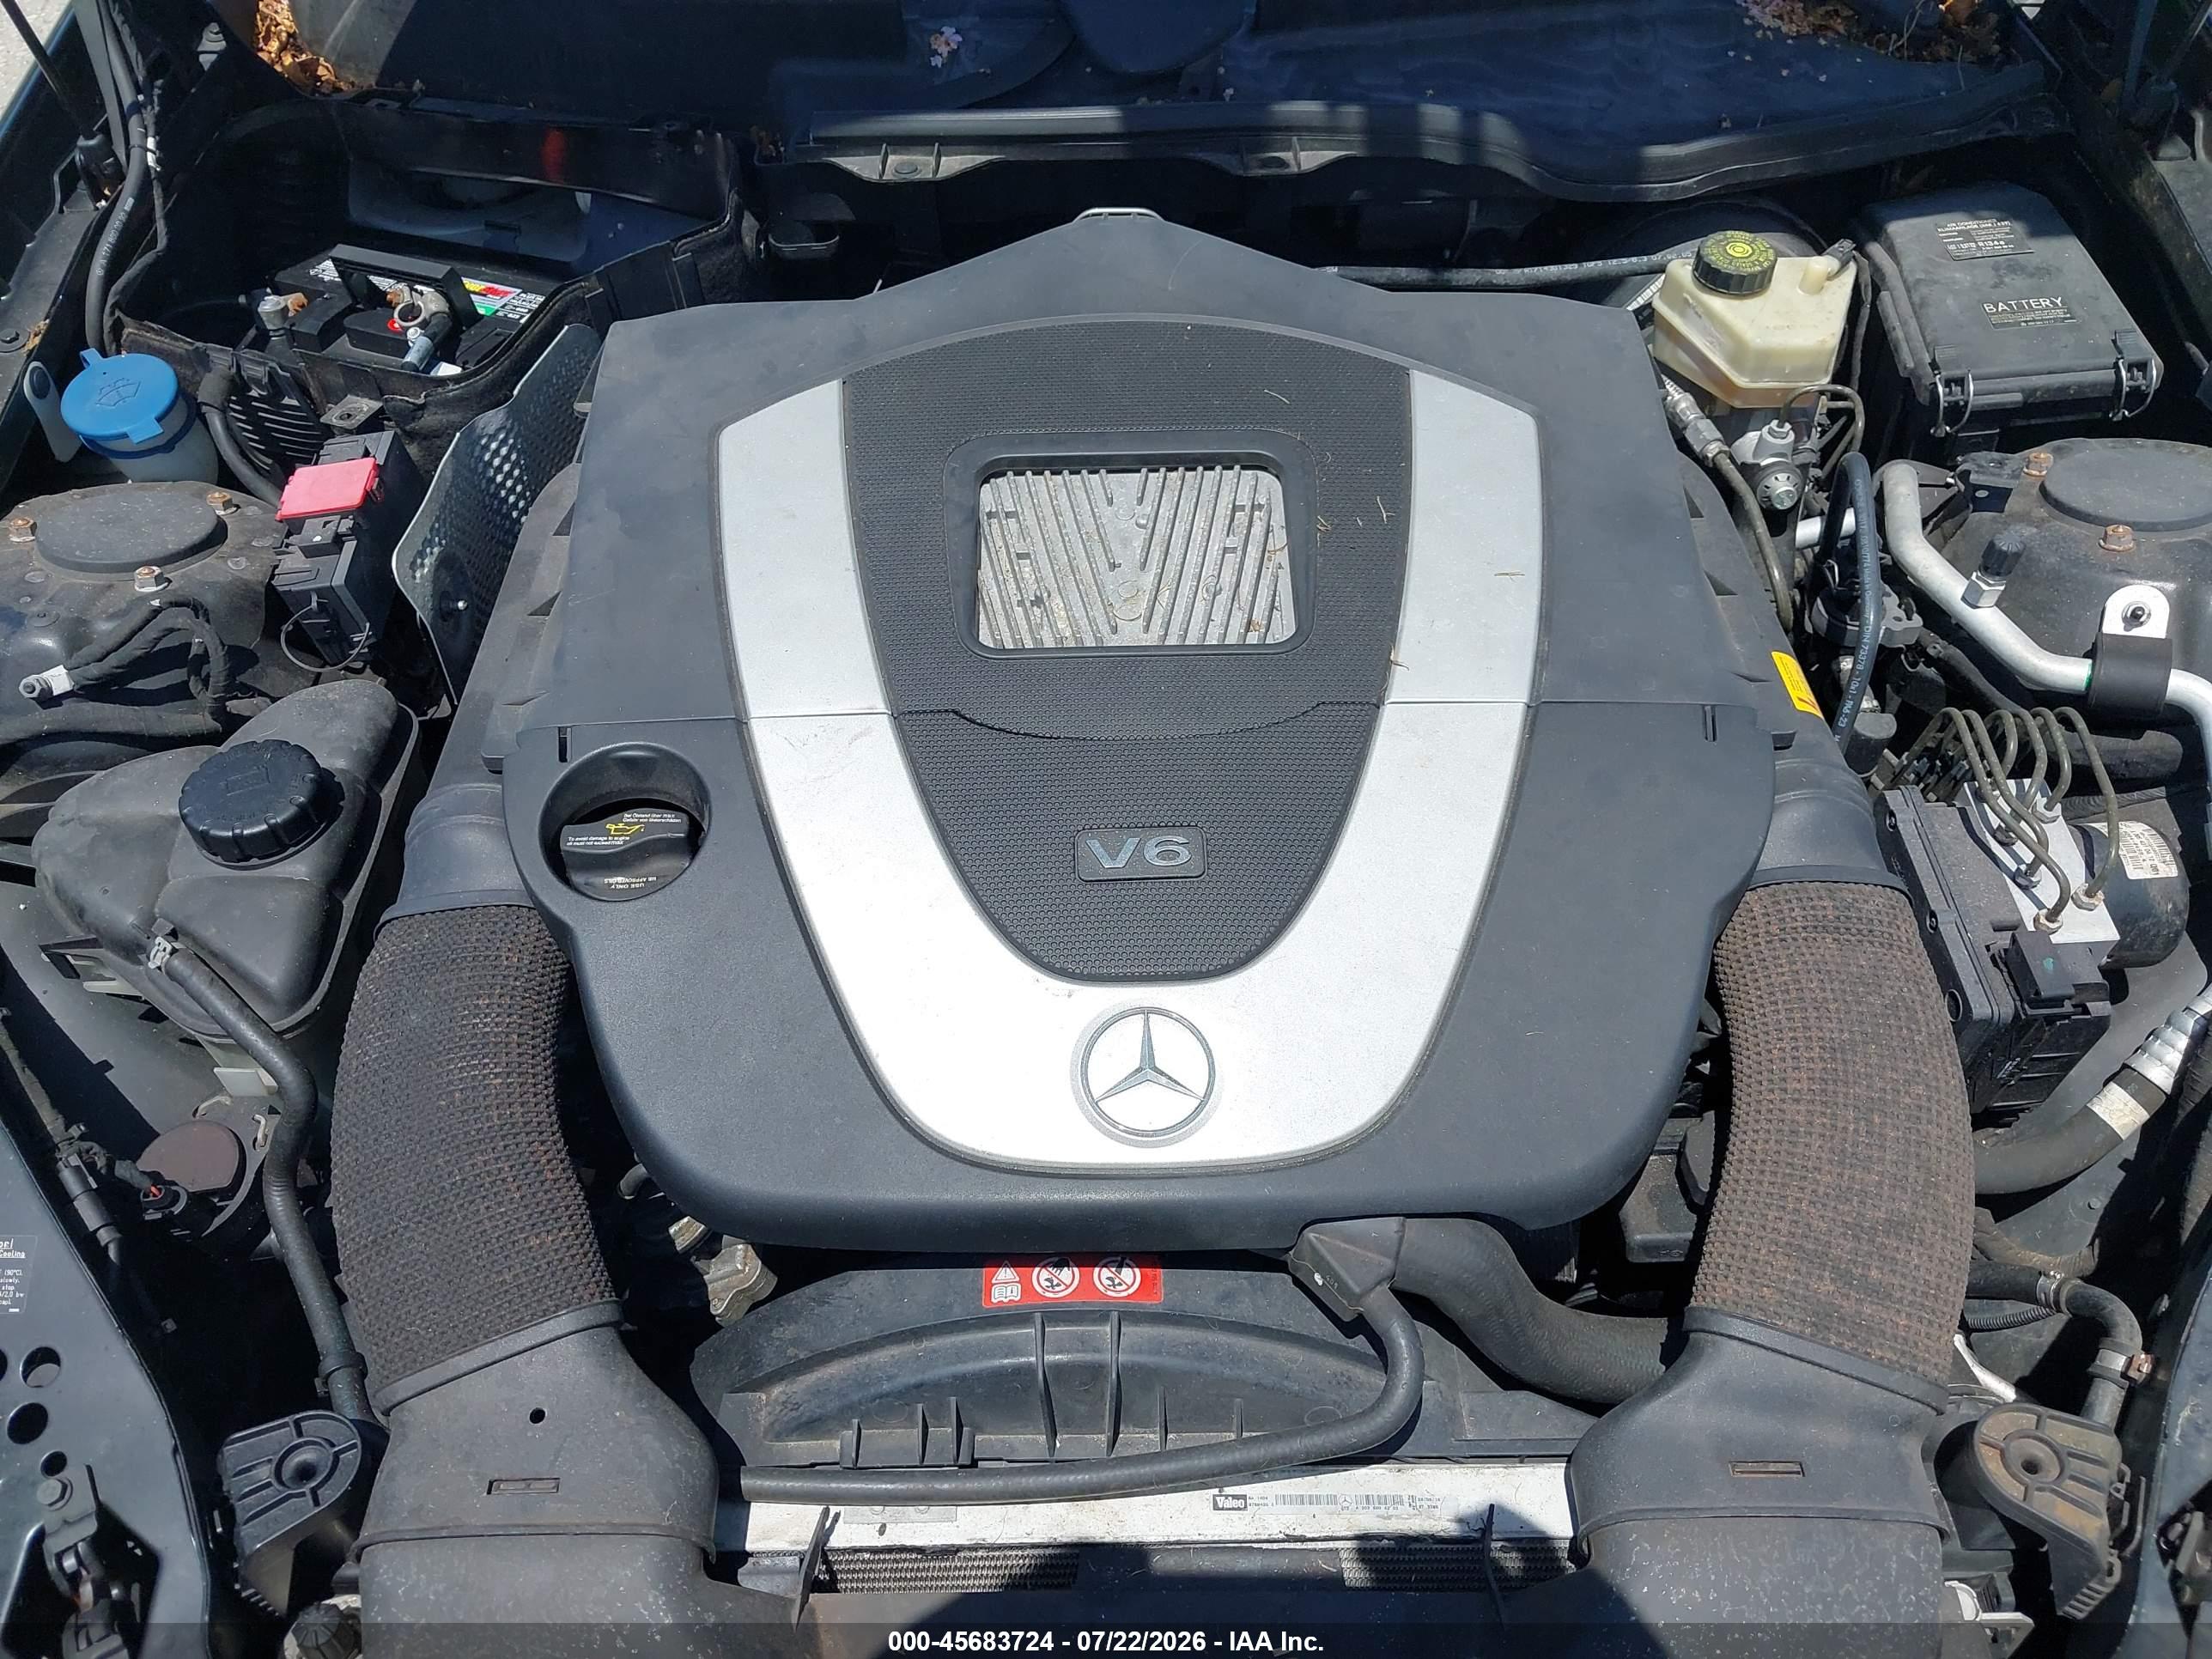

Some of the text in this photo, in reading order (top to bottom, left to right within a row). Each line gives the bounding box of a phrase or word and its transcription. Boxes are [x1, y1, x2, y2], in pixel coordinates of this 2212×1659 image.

[1983, 296, 2063, 313] BATTERY
[1862, 626, 1872, 643] DIN
[1856, 644, 1869, 671] 73378
[1085, 835, 1192, 869] V6
[1215, 1496, 1245, 1509] Valeo
